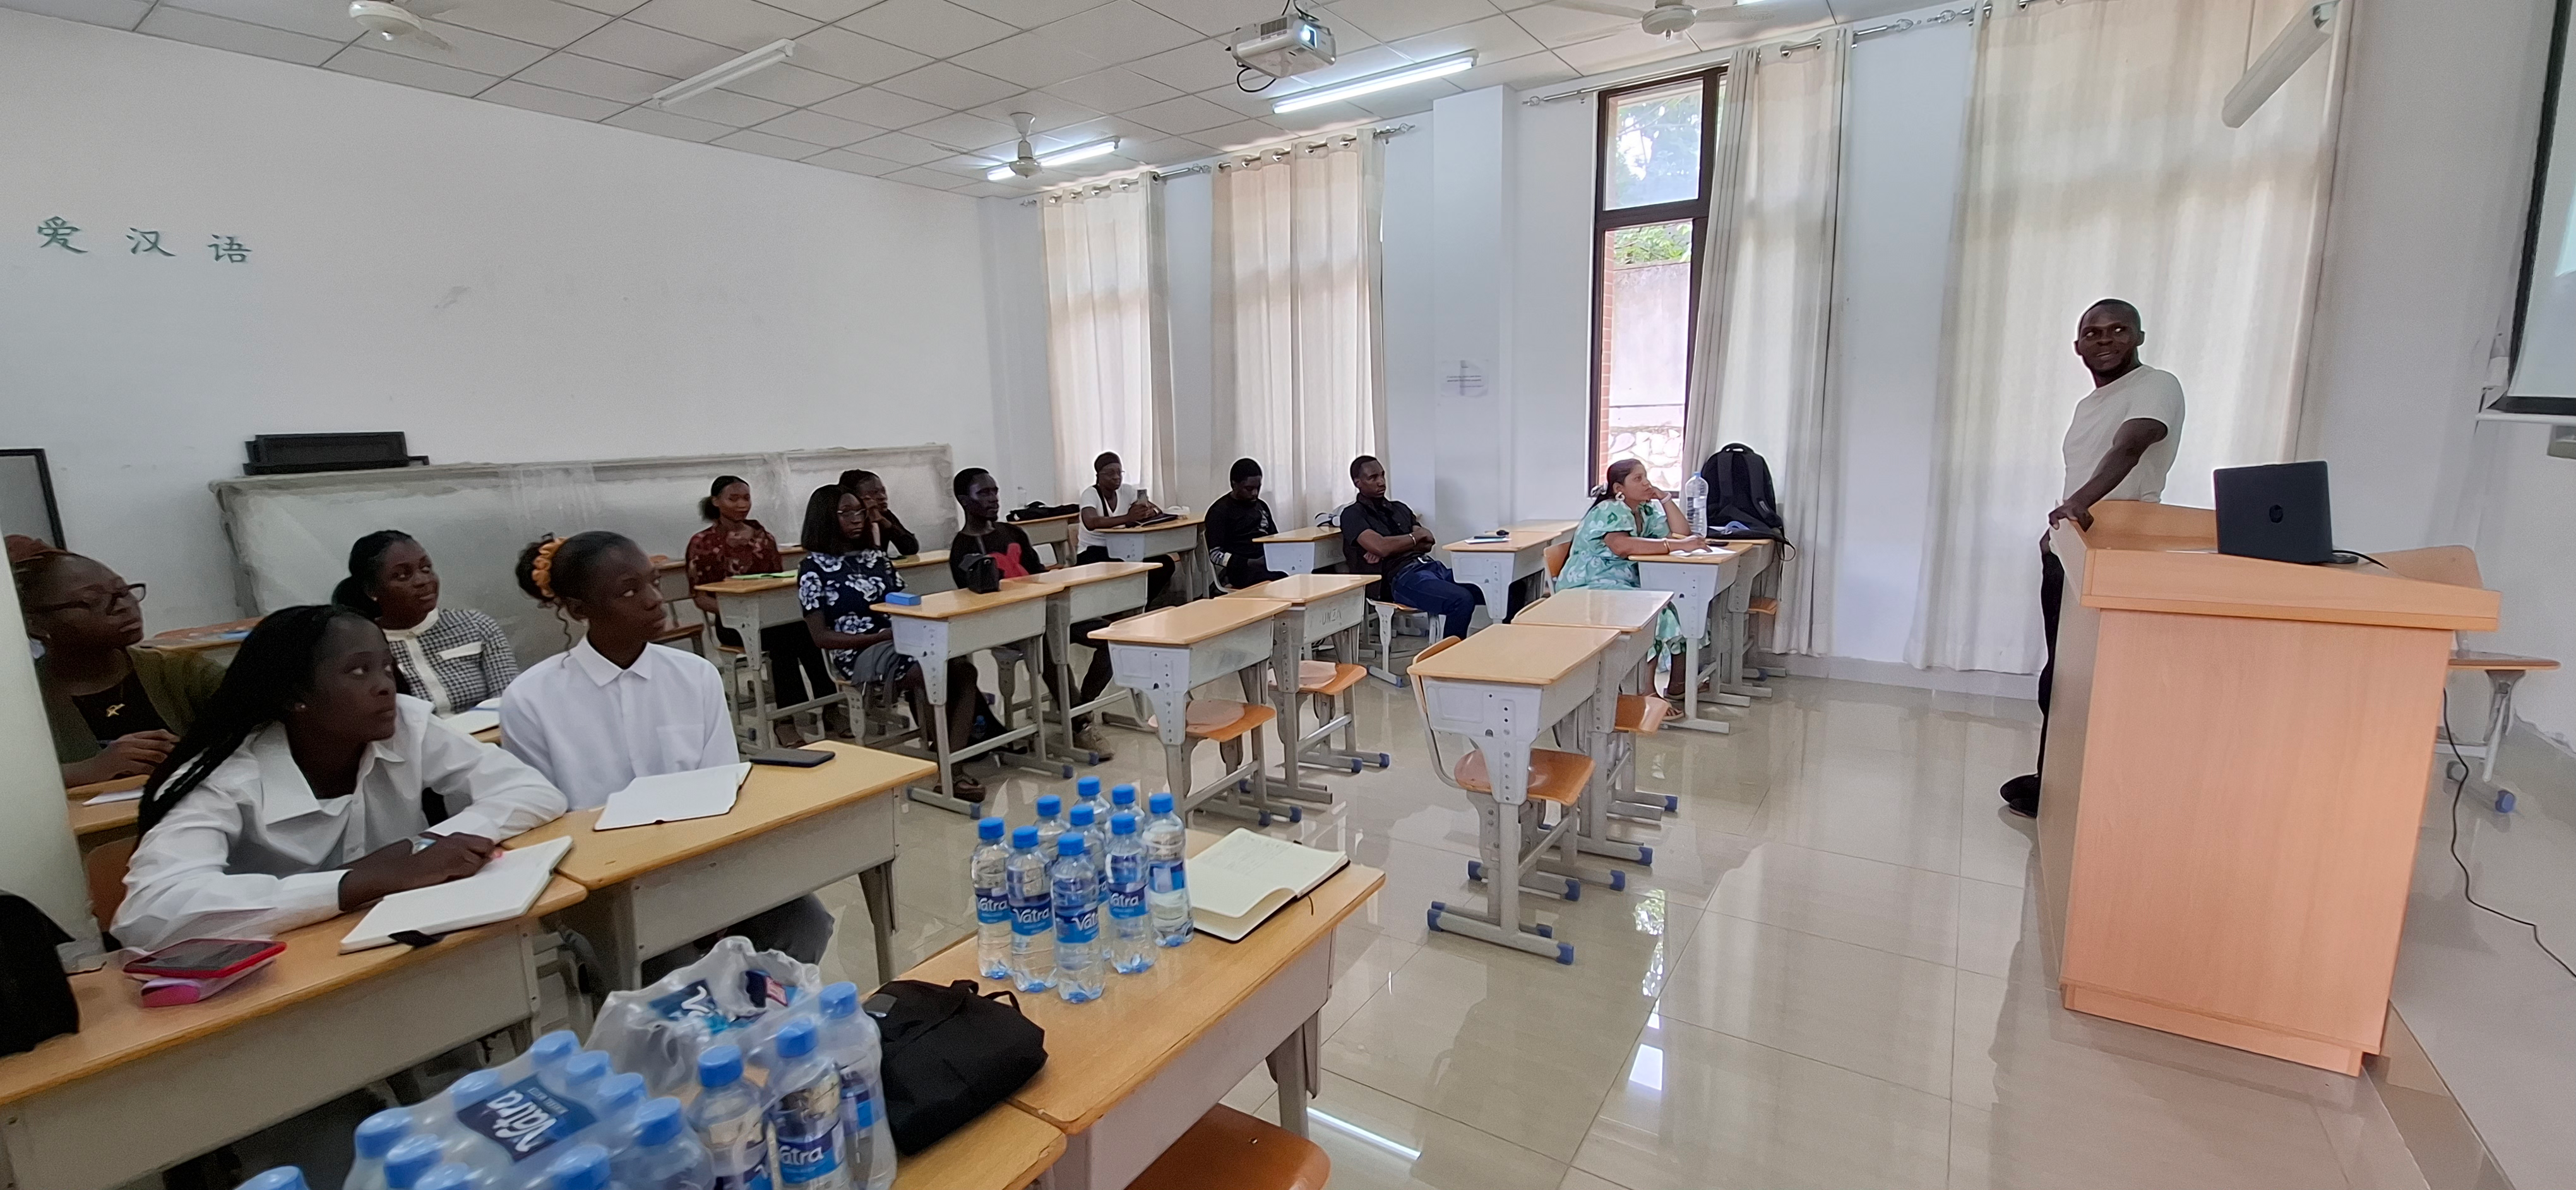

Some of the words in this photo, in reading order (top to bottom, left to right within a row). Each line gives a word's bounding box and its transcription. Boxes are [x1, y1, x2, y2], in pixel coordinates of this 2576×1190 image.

[38, 216, 253, 263] 爱汉语
[1012, 908, 1050, 923] Vatra
[1071, 912, 1099, 931] Vat
[486, 1090, 558, 1152] Vatra
